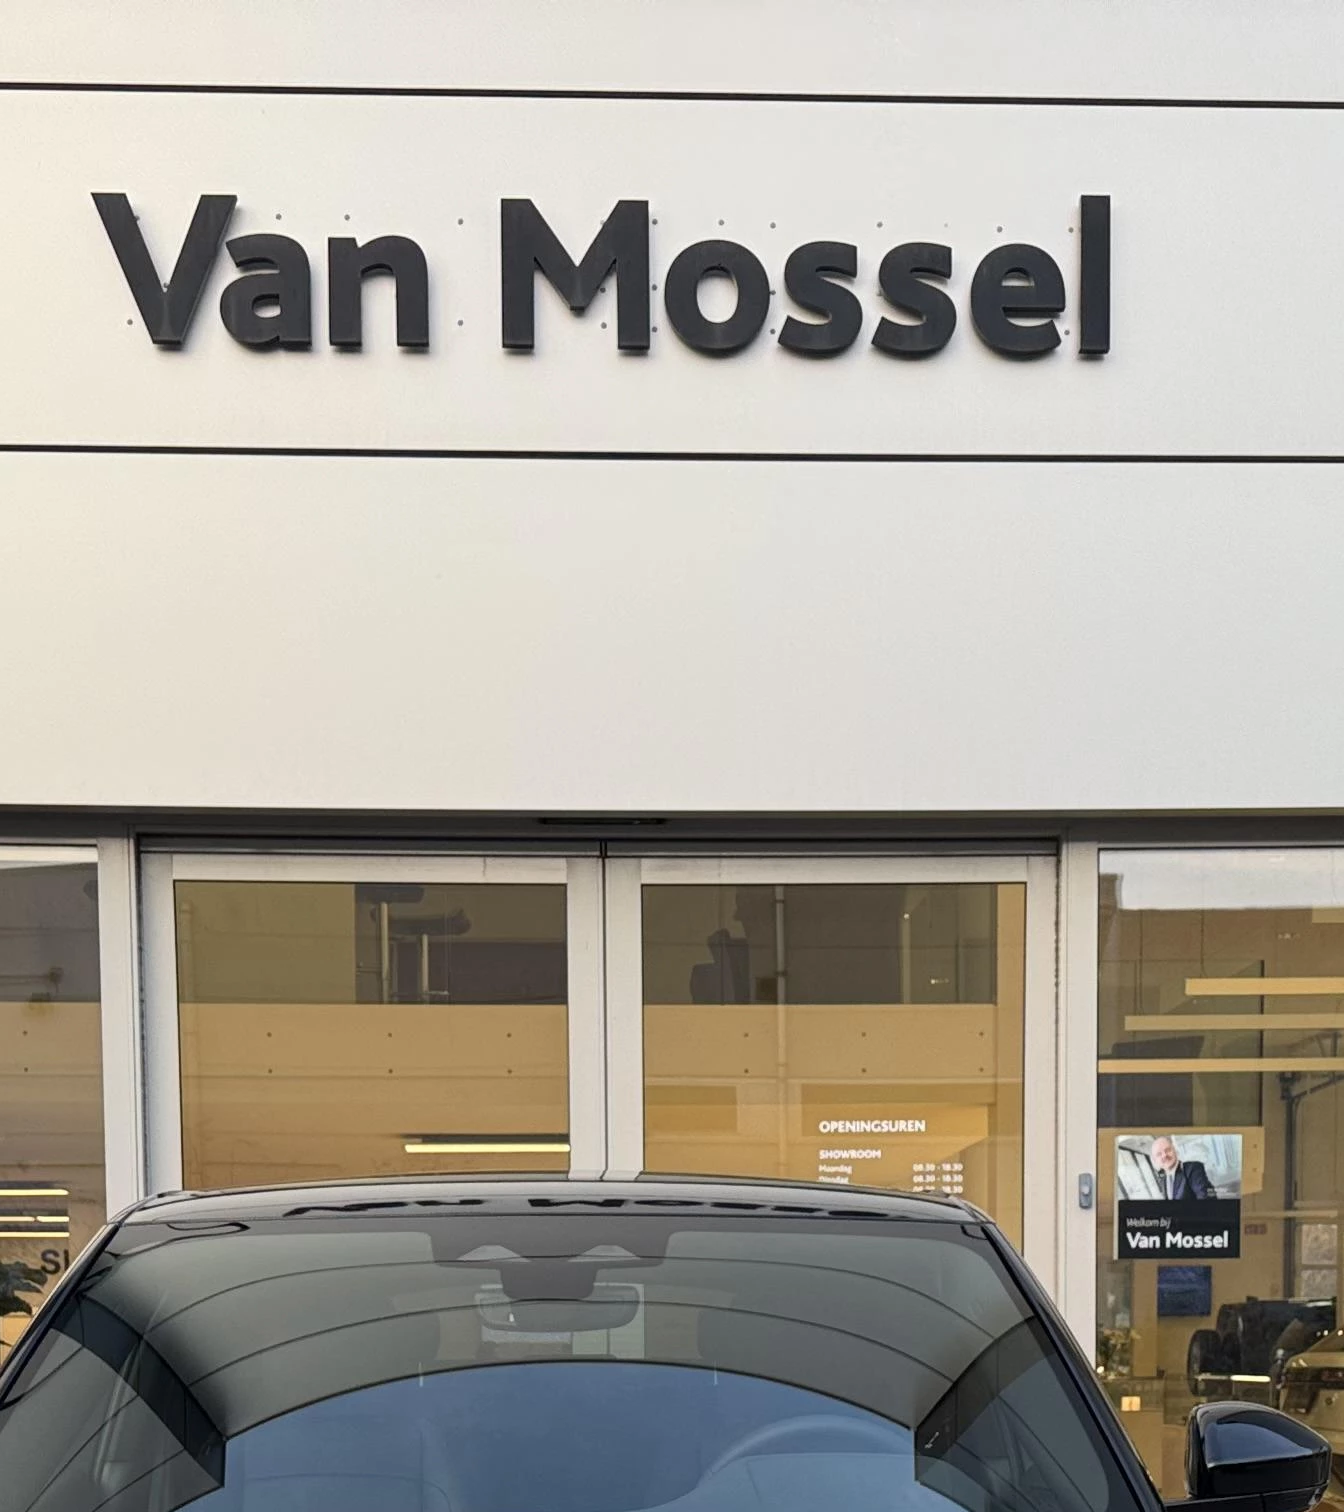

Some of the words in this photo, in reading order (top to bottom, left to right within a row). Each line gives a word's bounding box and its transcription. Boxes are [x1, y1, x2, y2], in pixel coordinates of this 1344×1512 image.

[90, 191, 430, 349] Van
[499, 193, 1111, 356] Mossel
[818, 1119, 926, 1133] OPENINGSUREN
[818, 1149, 882, 1160] SHOWROOM
[1126, 1217, 1160, 1228] Welkom
[1126, 1231, 1161, 1249] Van
[1165, 1230, 1229, 1249] Mossel
